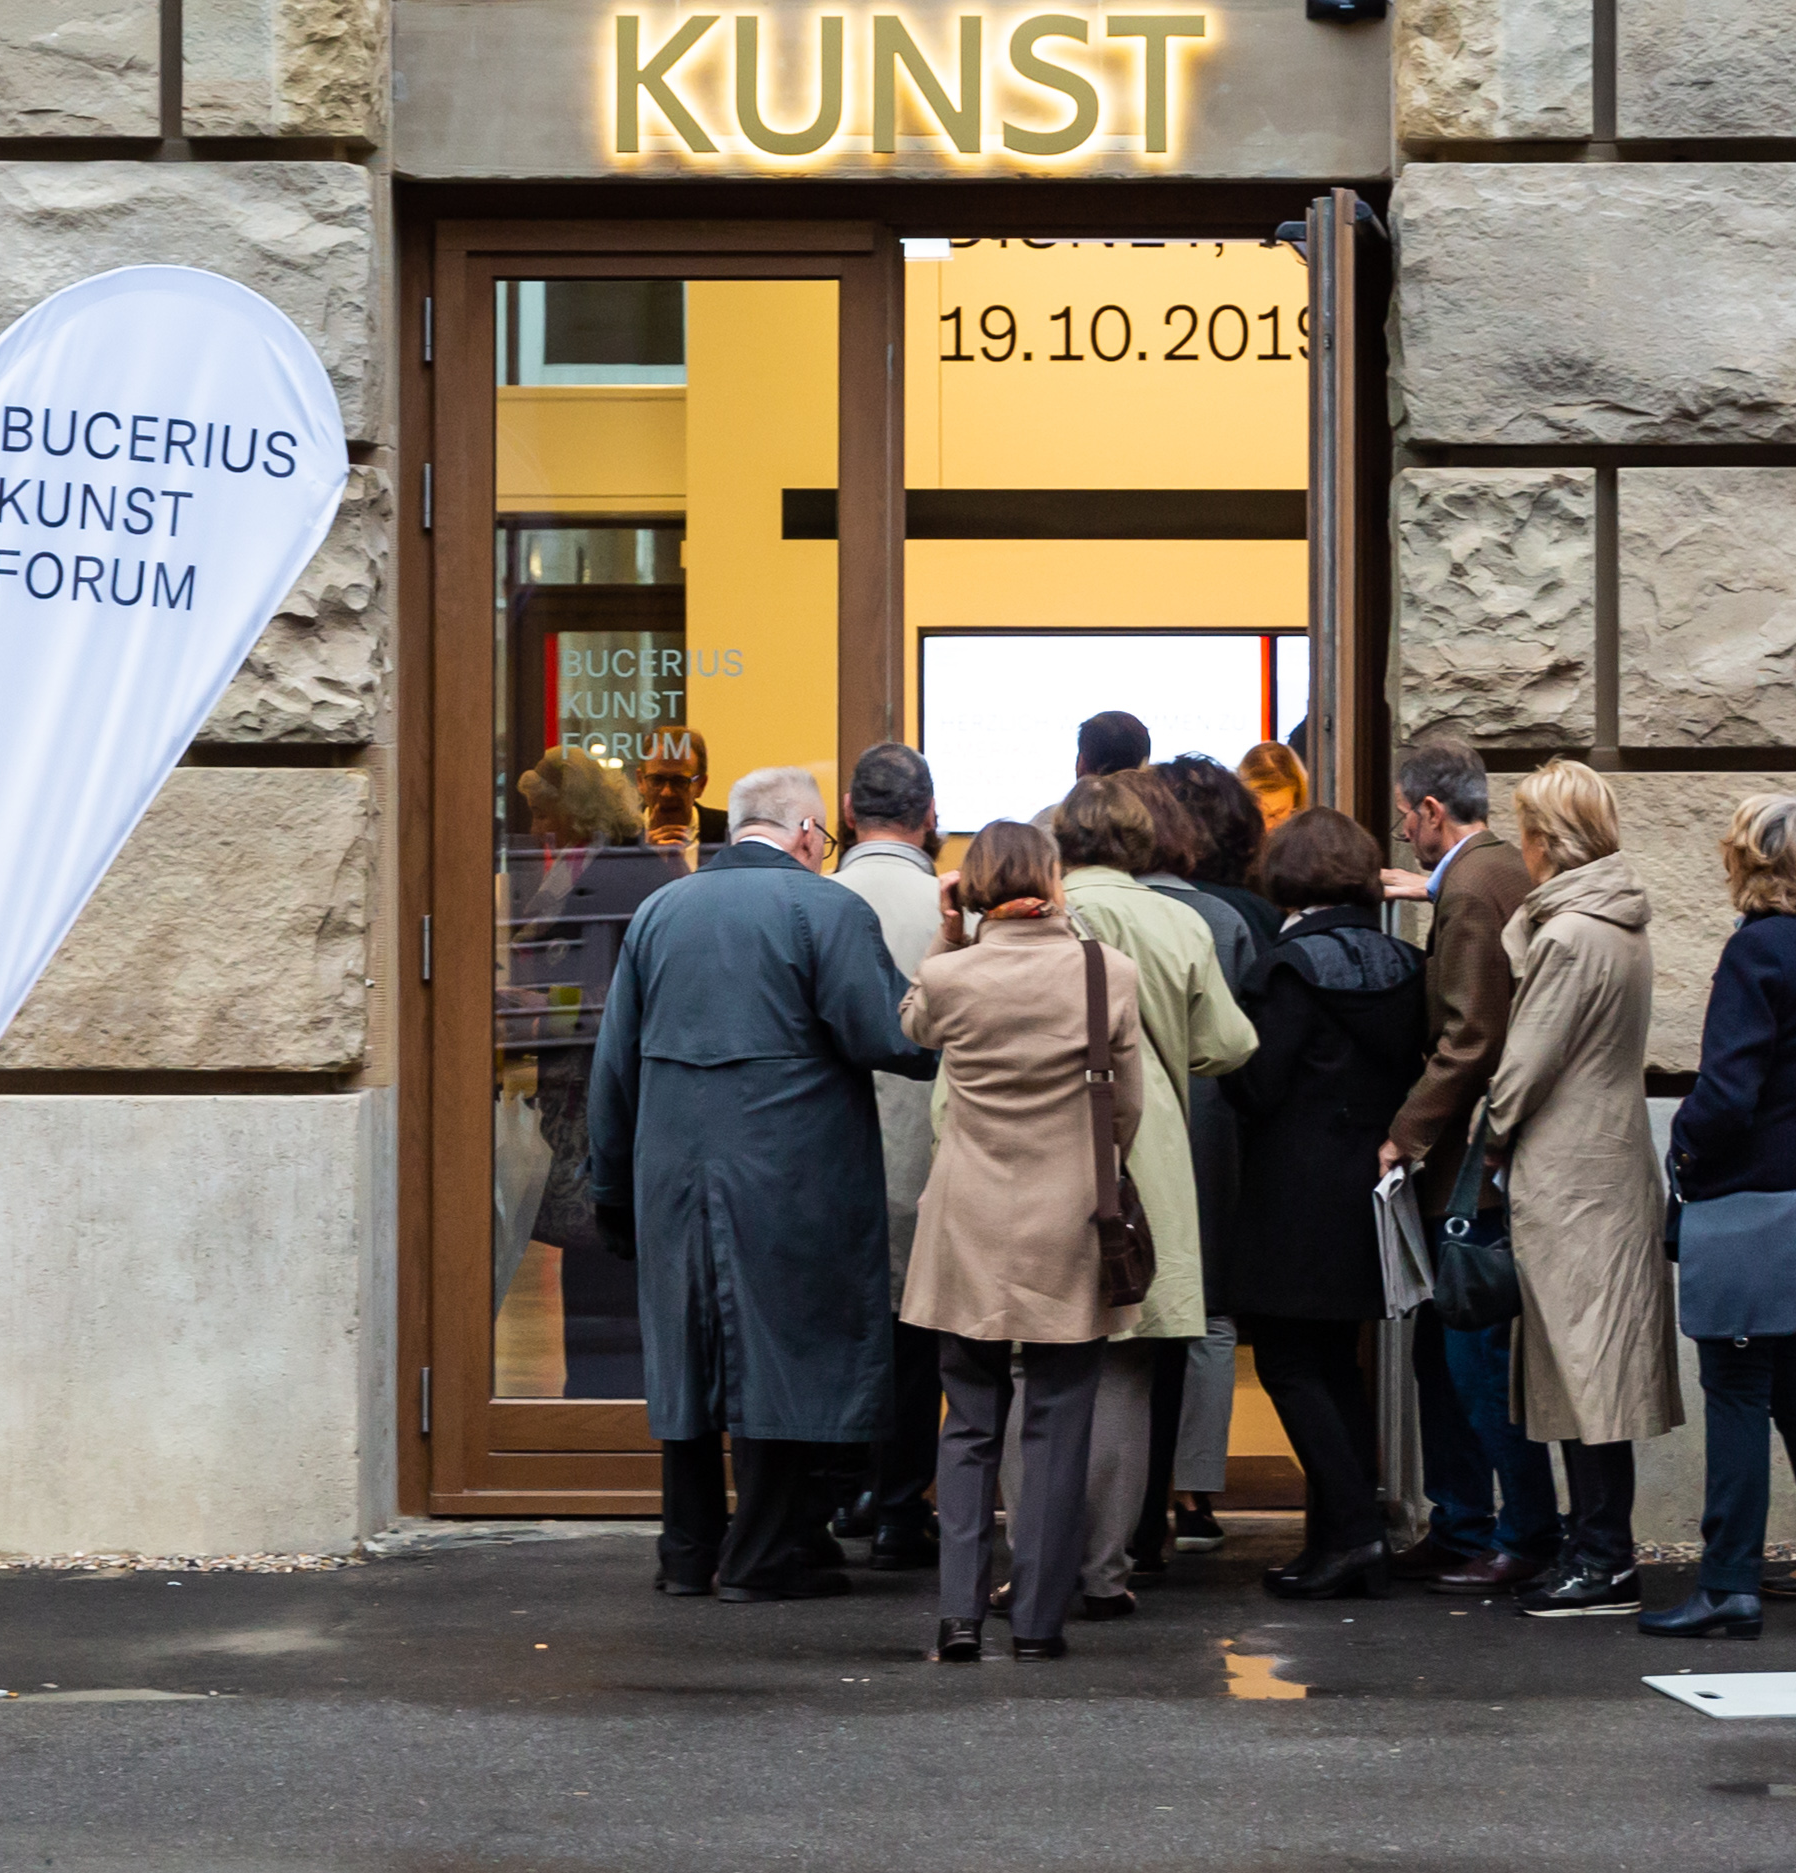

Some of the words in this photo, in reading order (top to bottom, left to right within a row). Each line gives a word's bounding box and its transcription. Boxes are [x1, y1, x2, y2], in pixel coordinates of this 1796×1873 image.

[616, 14, 1205, 155] KUNST
[0, 405, 298, 478] BUCERIUS
[561, 649, 744, 677] BUCERIUS
[561, 690, 684, 719] KUNST
[561, 732, 691, 760] FORUM
